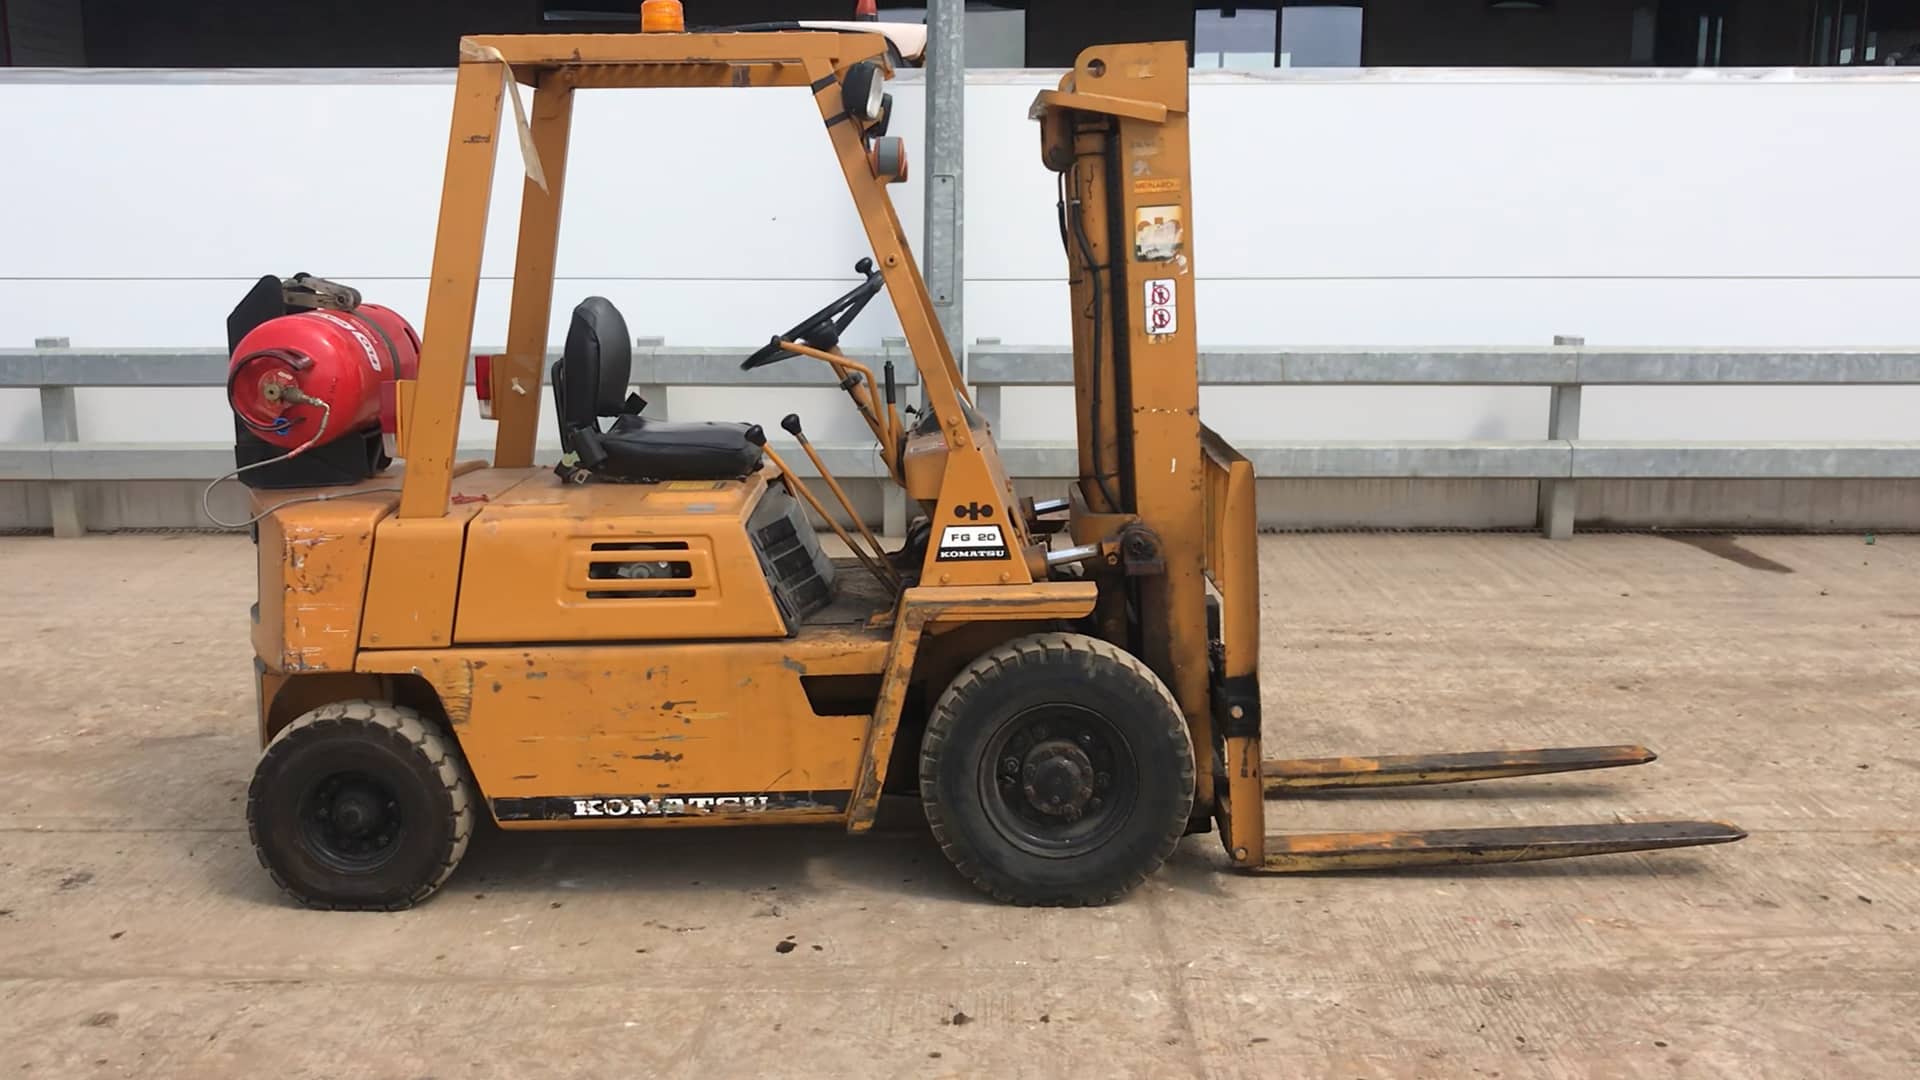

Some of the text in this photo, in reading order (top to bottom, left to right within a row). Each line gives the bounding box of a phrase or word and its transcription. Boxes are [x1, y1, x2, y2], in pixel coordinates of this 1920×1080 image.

[951, 533, 996, 542] FG 20
[940, 550, 1005, 558] KOMATSU
